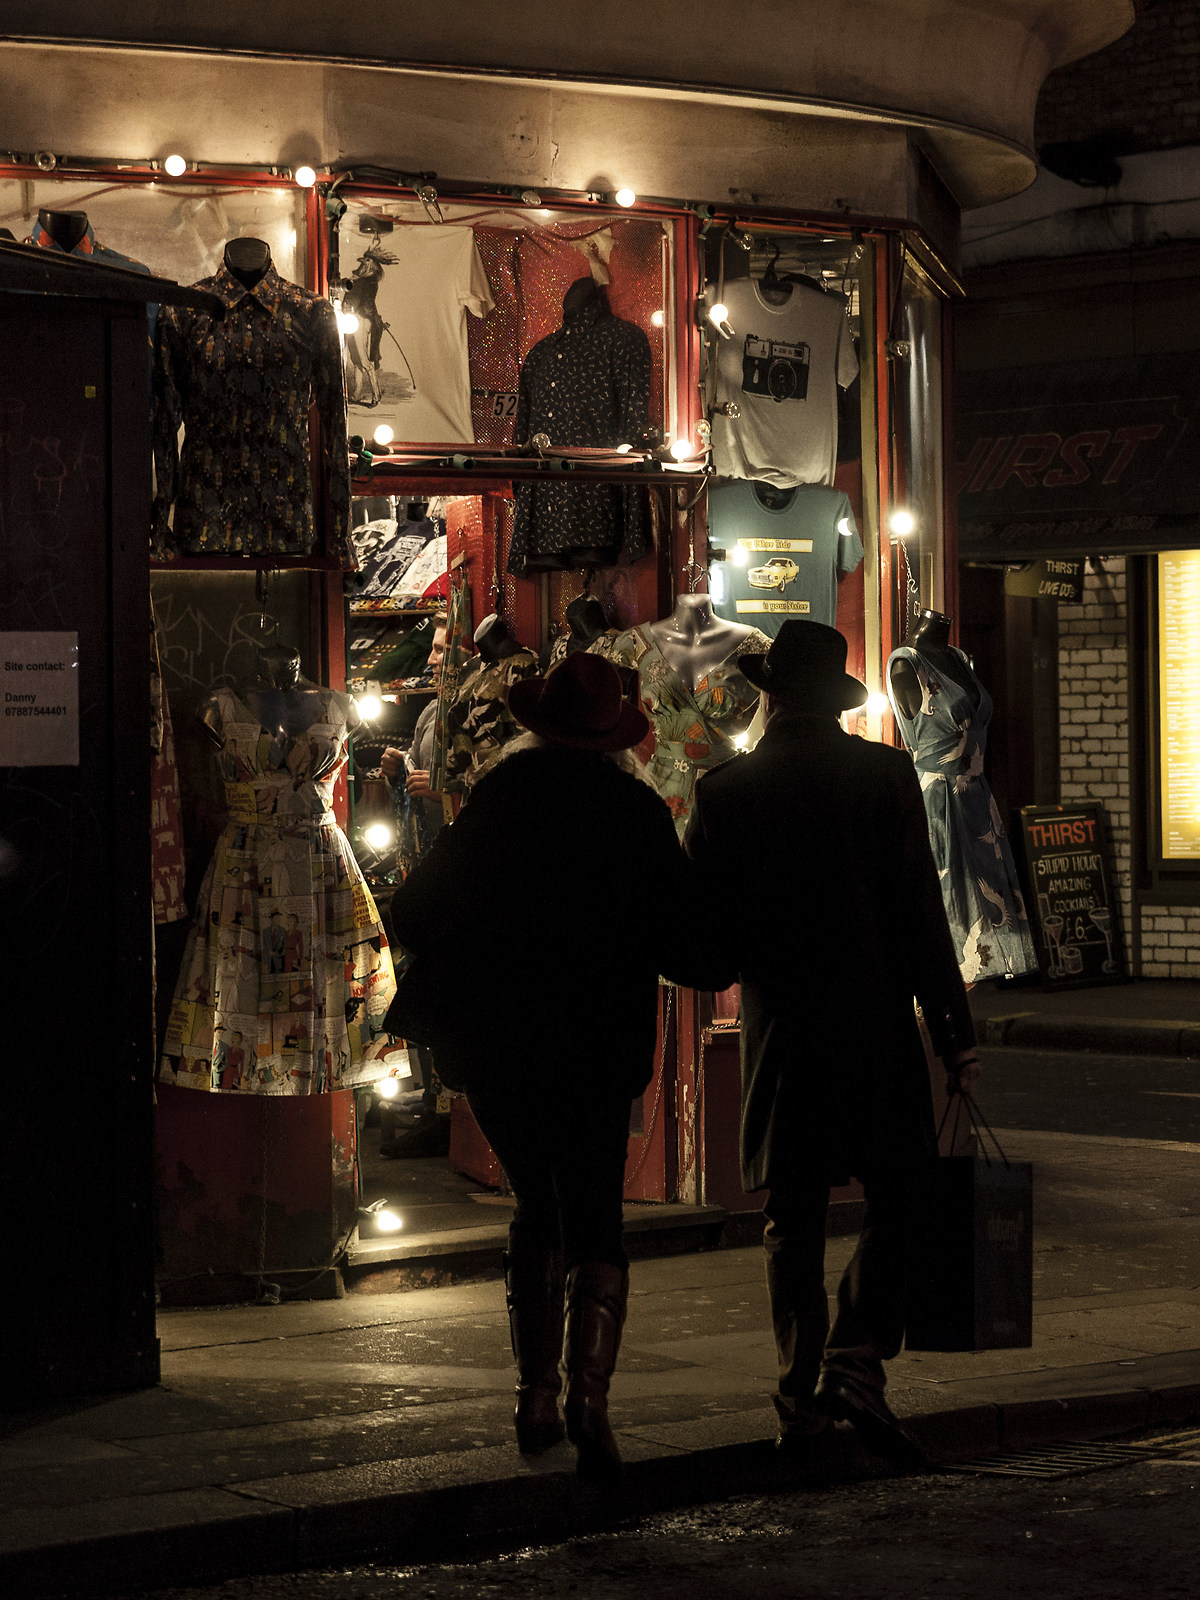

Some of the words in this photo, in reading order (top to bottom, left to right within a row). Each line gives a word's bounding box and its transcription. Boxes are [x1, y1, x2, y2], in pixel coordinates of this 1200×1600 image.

[494, 395, 517, 416] 52
[957, 425, 1165, 493] HIRST
[1045, 560, 1080, 576] THIRST
[1038, 580, 1059, 596] LIVE
[4, 661, 24, 671] Site
[26, 661, 66, 671] contact:
[5, 692, 37, 704] Danny
[5, 706, 67, 717] 07887544401
[1027, 820, 1096, 848] THIRST
[1037, 856, 1070, 876] STUPID
[1072, 854, 1100, 872] HOUR
[1049, 877, 1092, 893] AMAZING
